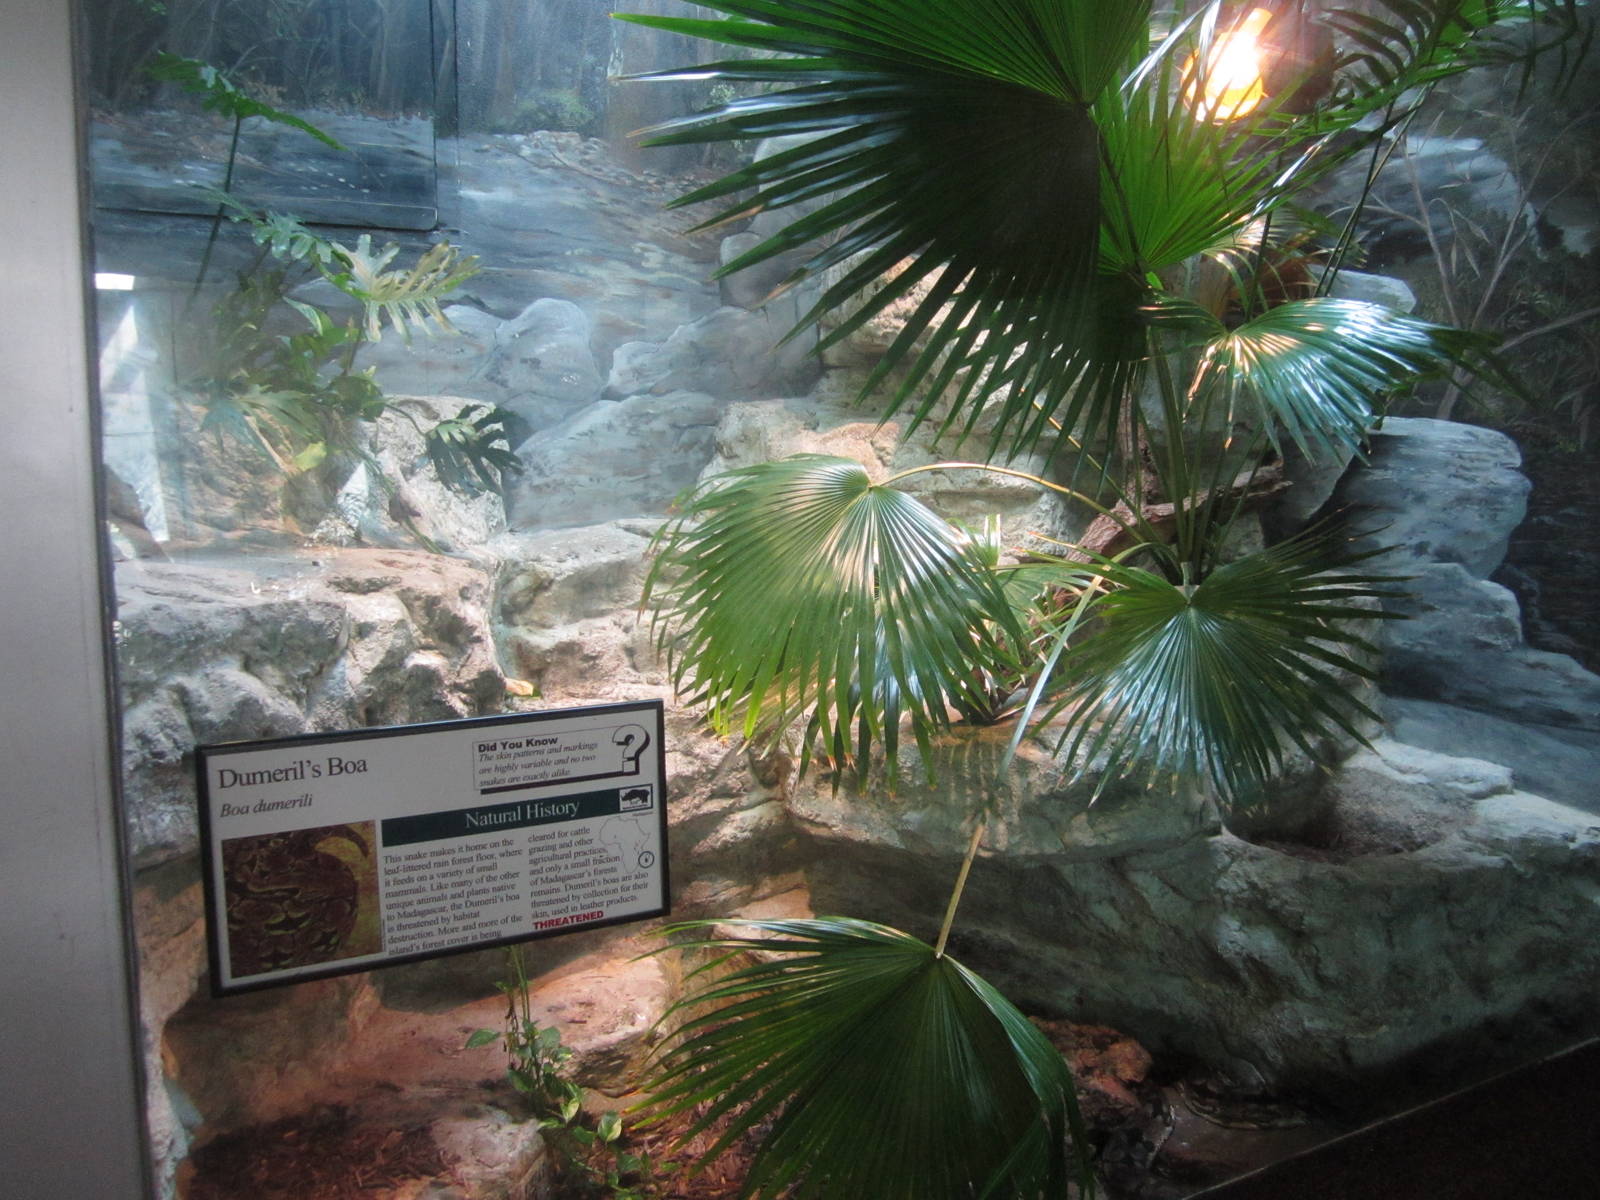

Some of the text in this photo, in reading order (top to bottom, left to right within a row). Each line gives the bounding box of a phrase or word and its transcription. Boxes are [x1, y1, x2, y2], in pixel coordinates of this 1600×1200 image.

[478, 736, 558, 753] Did You Know
[479, 742, 598, 762] The skin patterns and markings
[218, 757, 367, 789] Dumeril's Boa
[479, 766, 493, 775] are
[494, 762, 518, 775] highly
[521, 758, 552, 770] variable
[554, 756, 569, 765] and
[582, 754, 595, 762] two
[480, 777, 506, 787] snakes
[507, 775, 522, 783] are
[523, 772, 550, 782] exactly
[220, 794, 312, 818] Boa dumerili
[466, 802, 580, 828] Natural History
[528, 827, 590, 843] cleared for cattle
[384, 855, 402, 864] This
[404, 852, 427, 860] snake
[465, 843, 488, 852] home
[529, 838, 593, 856] grazing and other
[384, 849, 522, 875] leaf-littered rain forest floor, where
[529, 853, 571, 865] agricultural
[530, 866, 543, 876] and
[545, 864, 562, 874] only
[571, 859, 590, 868] small
[593, 856, 620, 866] fraction
[393, 875, 414, 886] feeds
[436, 868, 463, 879] variety
[466, 865, 474, 874] of
[476, 863, 498, 872] small
[430, 883, 449, 892] Like
[451, 880, 472, 889] many
[475, 877, 484, 885] of
[500, 872, 520, 881] other
[530, 877, 538, 886] of
[540, 872, 591, 884] Madagascar's
[565, 880, 601, 892] Dumeril's
[603, 876, 619, 885] boas
[634, 872, 648, 880] also
[386, 884, 515, 910] unique animals and plants native
[531, 882, 648, 908] threatened by collection for their
[387, 913, 395, 921] to
[451, 902, 463, 911] the
[465, 896, 504, 908] Dumeril's
[506, 894, 520, 902] boa
[531, 910, 550, 919] skin,
[552, 906, 568, 915] used
[580, 901, 605, 910] leather
[397, 918, 439, 931] threatened
[441, 917, 451, 928] by
[453, 911, 480, 922] habitat
[438, 927, 459, 935] More
[462, 922, 476, 931] and
[533, 911, 604, 929] THREATENED
[422, 939, 446, 949] forest
[447, 937, 469, 945] cover
